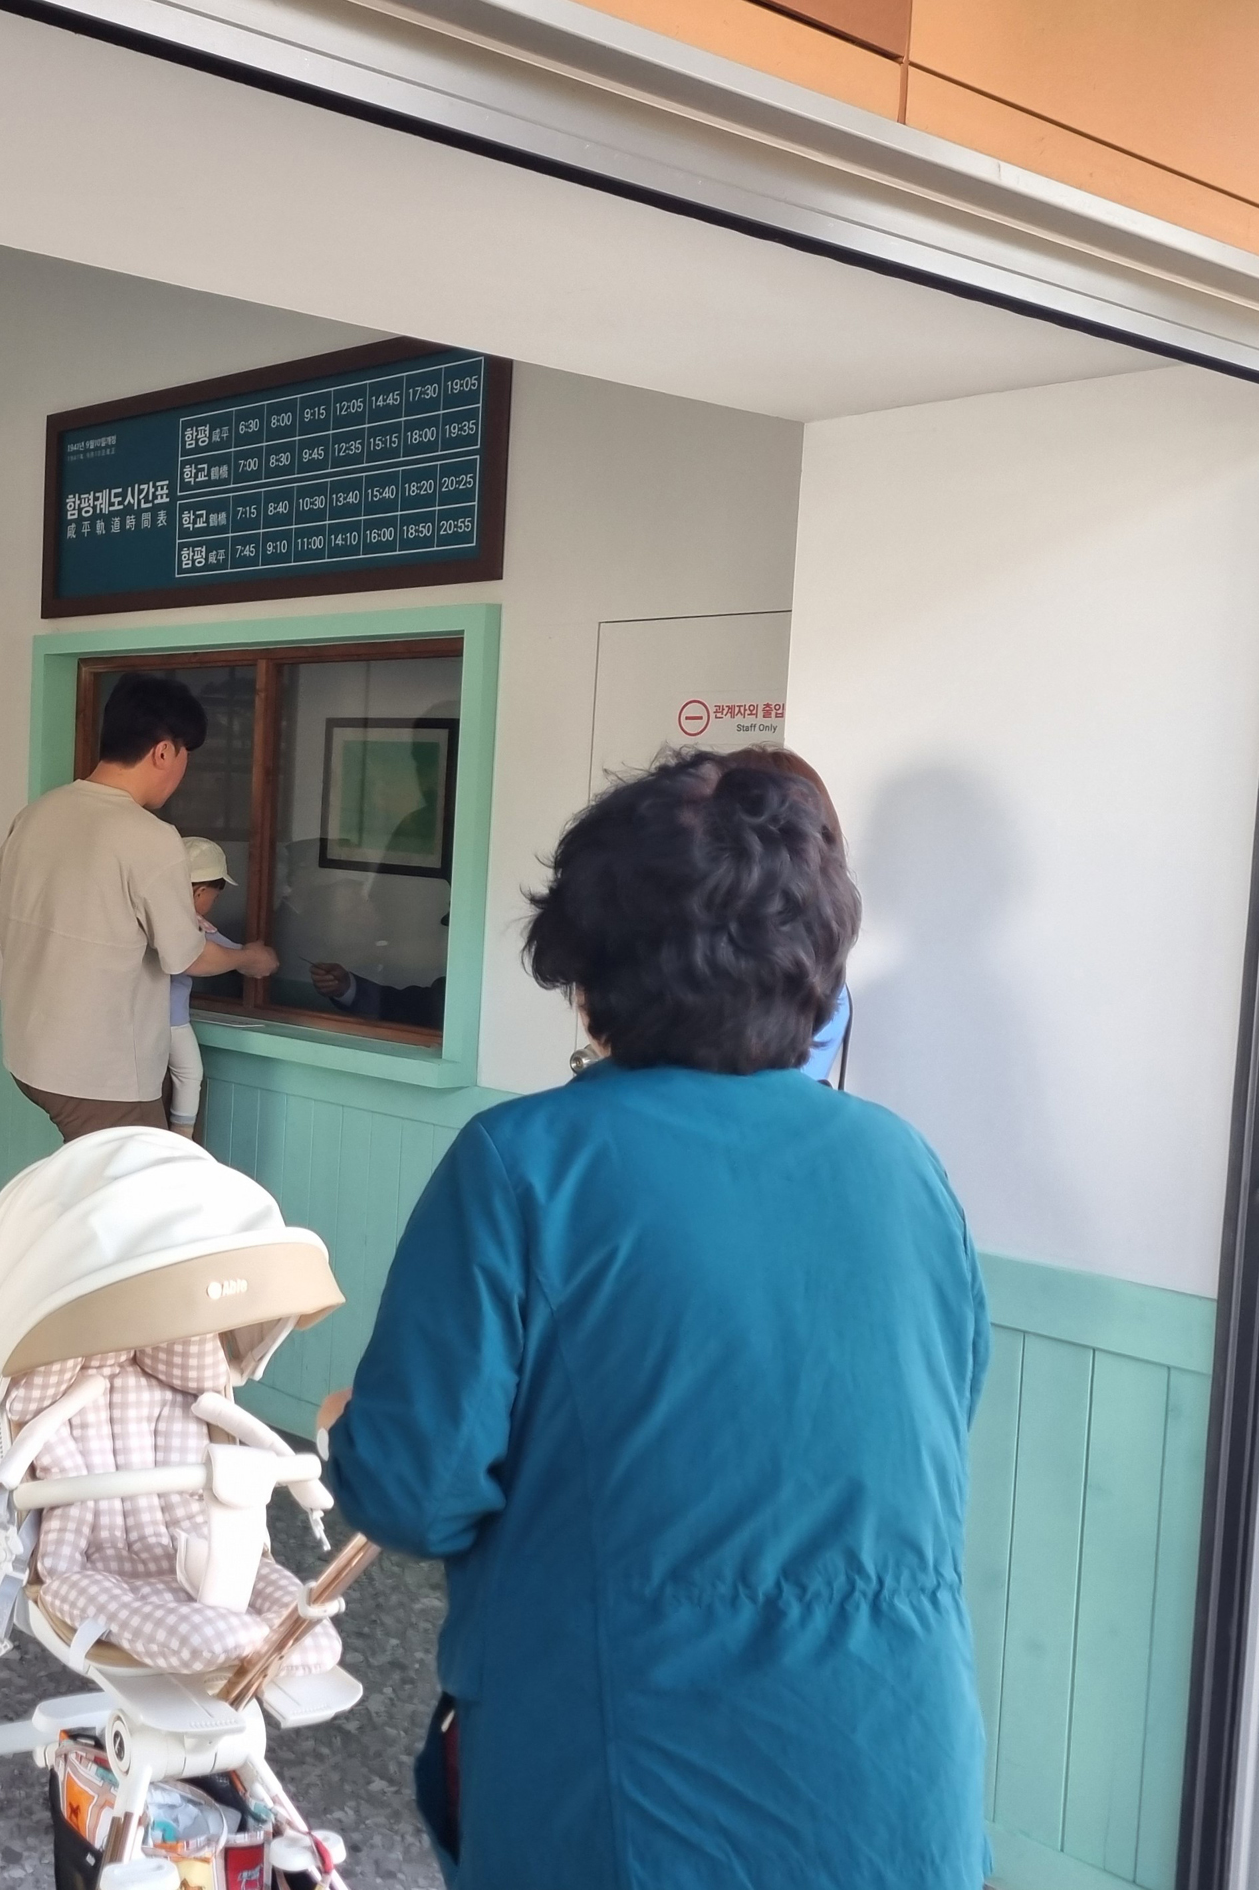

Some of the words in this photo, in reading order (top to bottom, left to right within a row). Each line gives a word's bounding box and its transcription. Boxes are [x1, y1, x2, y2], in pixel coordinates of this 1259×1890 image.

[239, 418, 259, 434] 6:30
[271, 412, 292, 428] 8:00
[304, 406, 326, 422] 9:15
[336, 398, 364, 416] 12:05
[372, 391, 401, 409] 14:45
[409, 384, 439, 402] 17:30
[447, 376, 478, 394] 19:05
[184, 424, 210, 449] 함평
[238, 458, 258, 472] 7:00
[269, 452, 291, 467] 8:30
[302, 446, 324, 462] 9:45
[334, 440, 362, 457] 12:35
[370, 434, 399, 451] 15:15
[407, 427, 436, 444] 18:00
[445, 420, 476, 438] 19:35
[183, 463, 208, 485] 학교
[66, 480, 170, 520] 함평궤도시간표
[236, 505, 257, 520] 7:15
[268, 500, 289, 516] 8:40
[299, 495, 325, 511] 10:30
[332, 490, 360, 507] 13:40
[367, 485, 396, 502] 15:40
[404, 480, 435, 497] 18:20
[441, 474, 474, 492] 20:25
[182, 510, 207, 531] 학교
[236, 544, 256, 558] 7:45
[266, 540, 288, 554] 9:10
[297, 535, 324, 551] 11:00
[330, 531, 359, 547] 14:10
[366, 527, 395, 543] 16:00
[403, 522, 433, 539] 18:50
[440, 517, 472, 535] 20:55
[180, 545, 206, 569] 함평
[713, 704, 758, 720] 관계자외
[761, 702, 785, 719] 출입
[736, 723, 757, 732] Staff
[758, 723, 778, 733] Only
